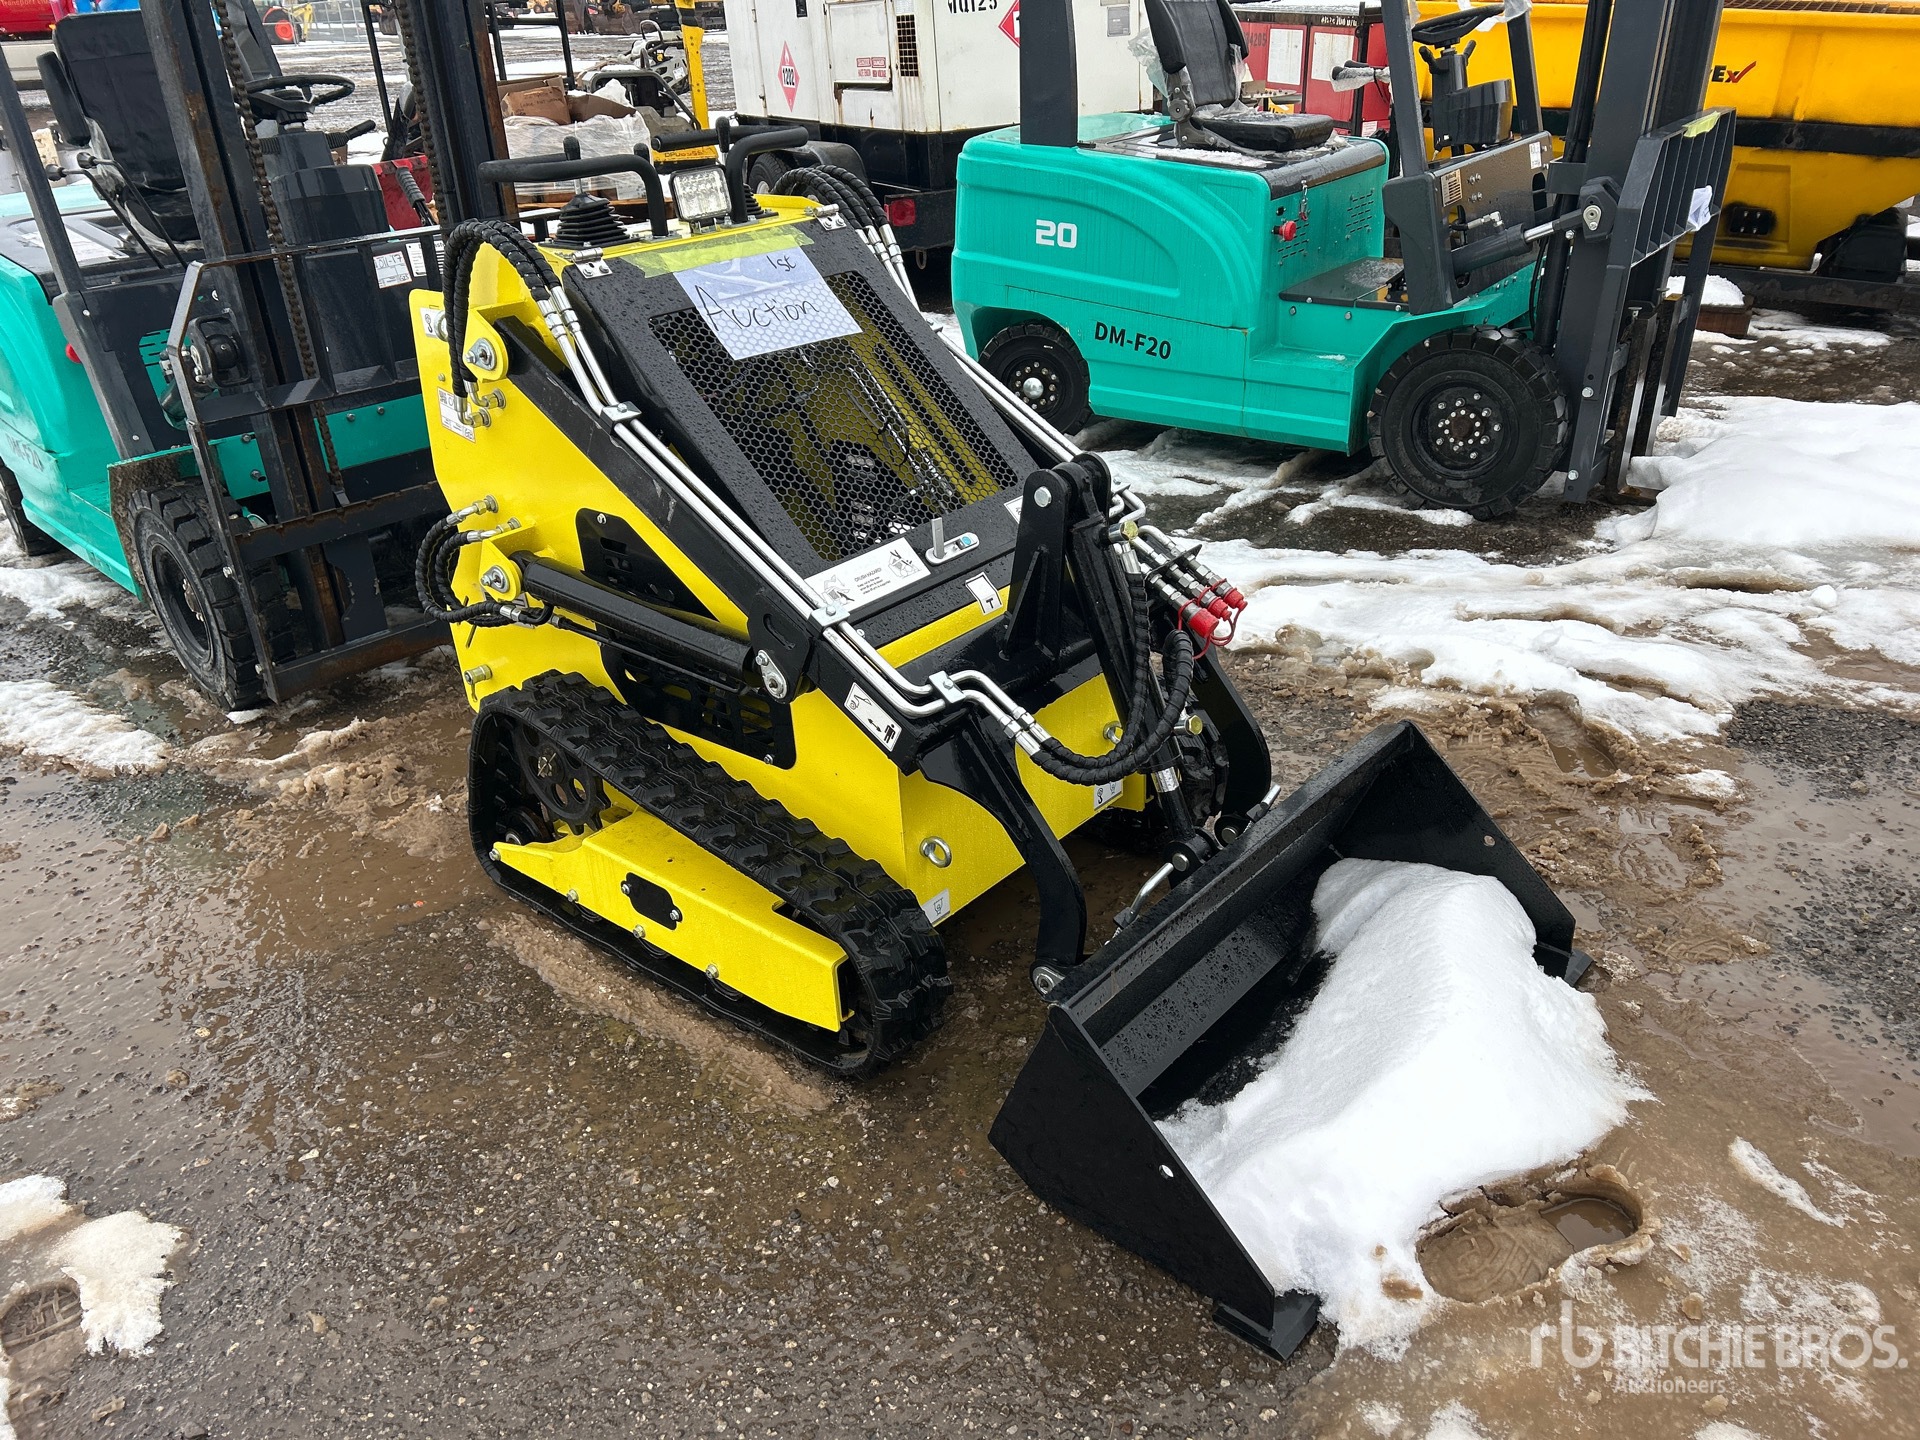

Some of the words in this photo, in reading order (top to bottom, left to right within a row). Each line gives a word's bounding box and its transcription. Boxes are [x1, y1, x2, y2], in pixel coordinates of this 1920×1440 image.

[1035, 219, 1078, 249] 20
[766, 255, 797, 272] 1st
[694, 285, 820, 332] Auction
[1094, 321, 1172, 360] DM-F20
